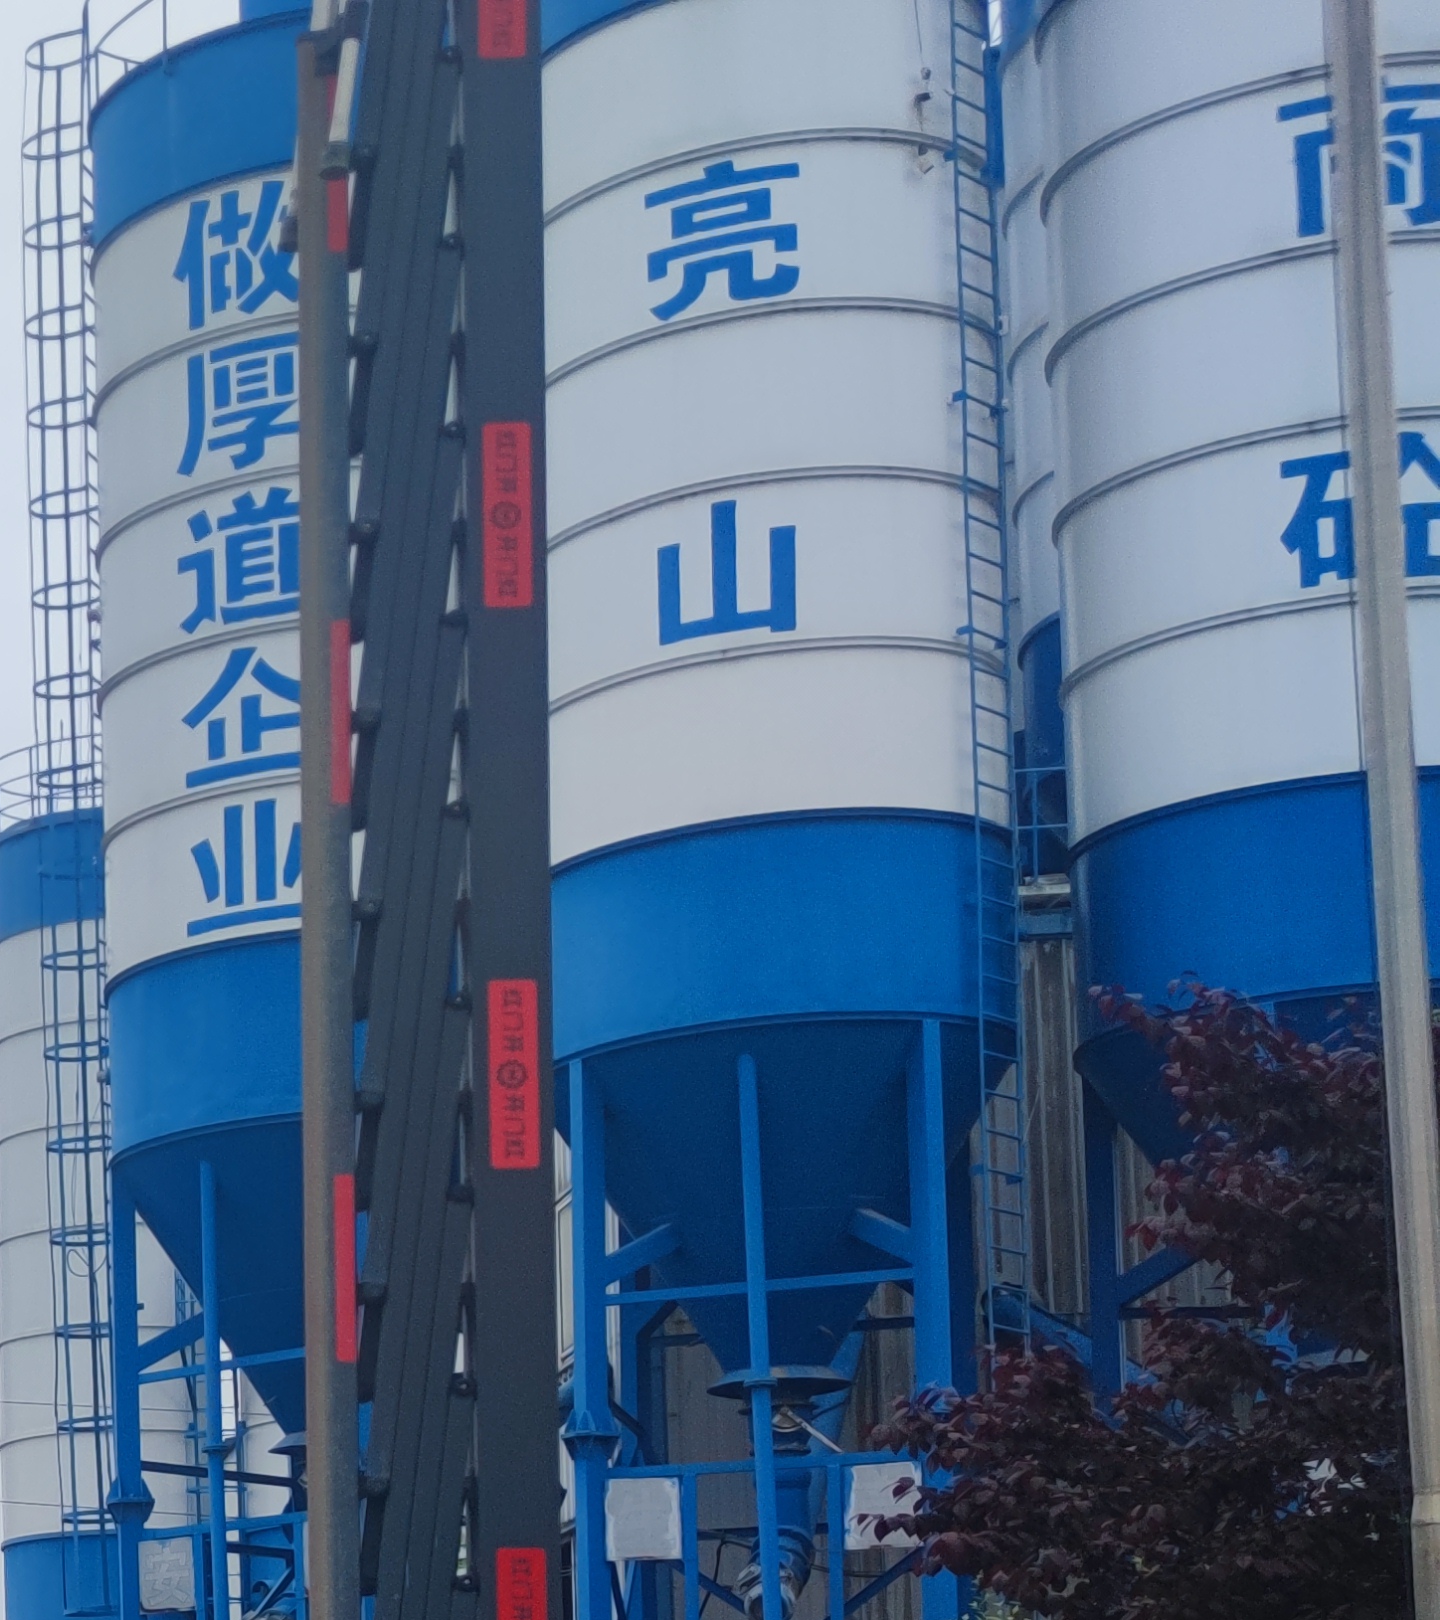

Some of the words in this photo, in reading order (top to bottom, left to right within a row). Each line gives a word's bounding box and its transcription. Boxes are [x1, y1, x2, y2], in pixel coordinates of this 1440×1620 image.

[173, 180, 302, 937] 做厚道企业
[645, 160, 801, 647] 亮山
